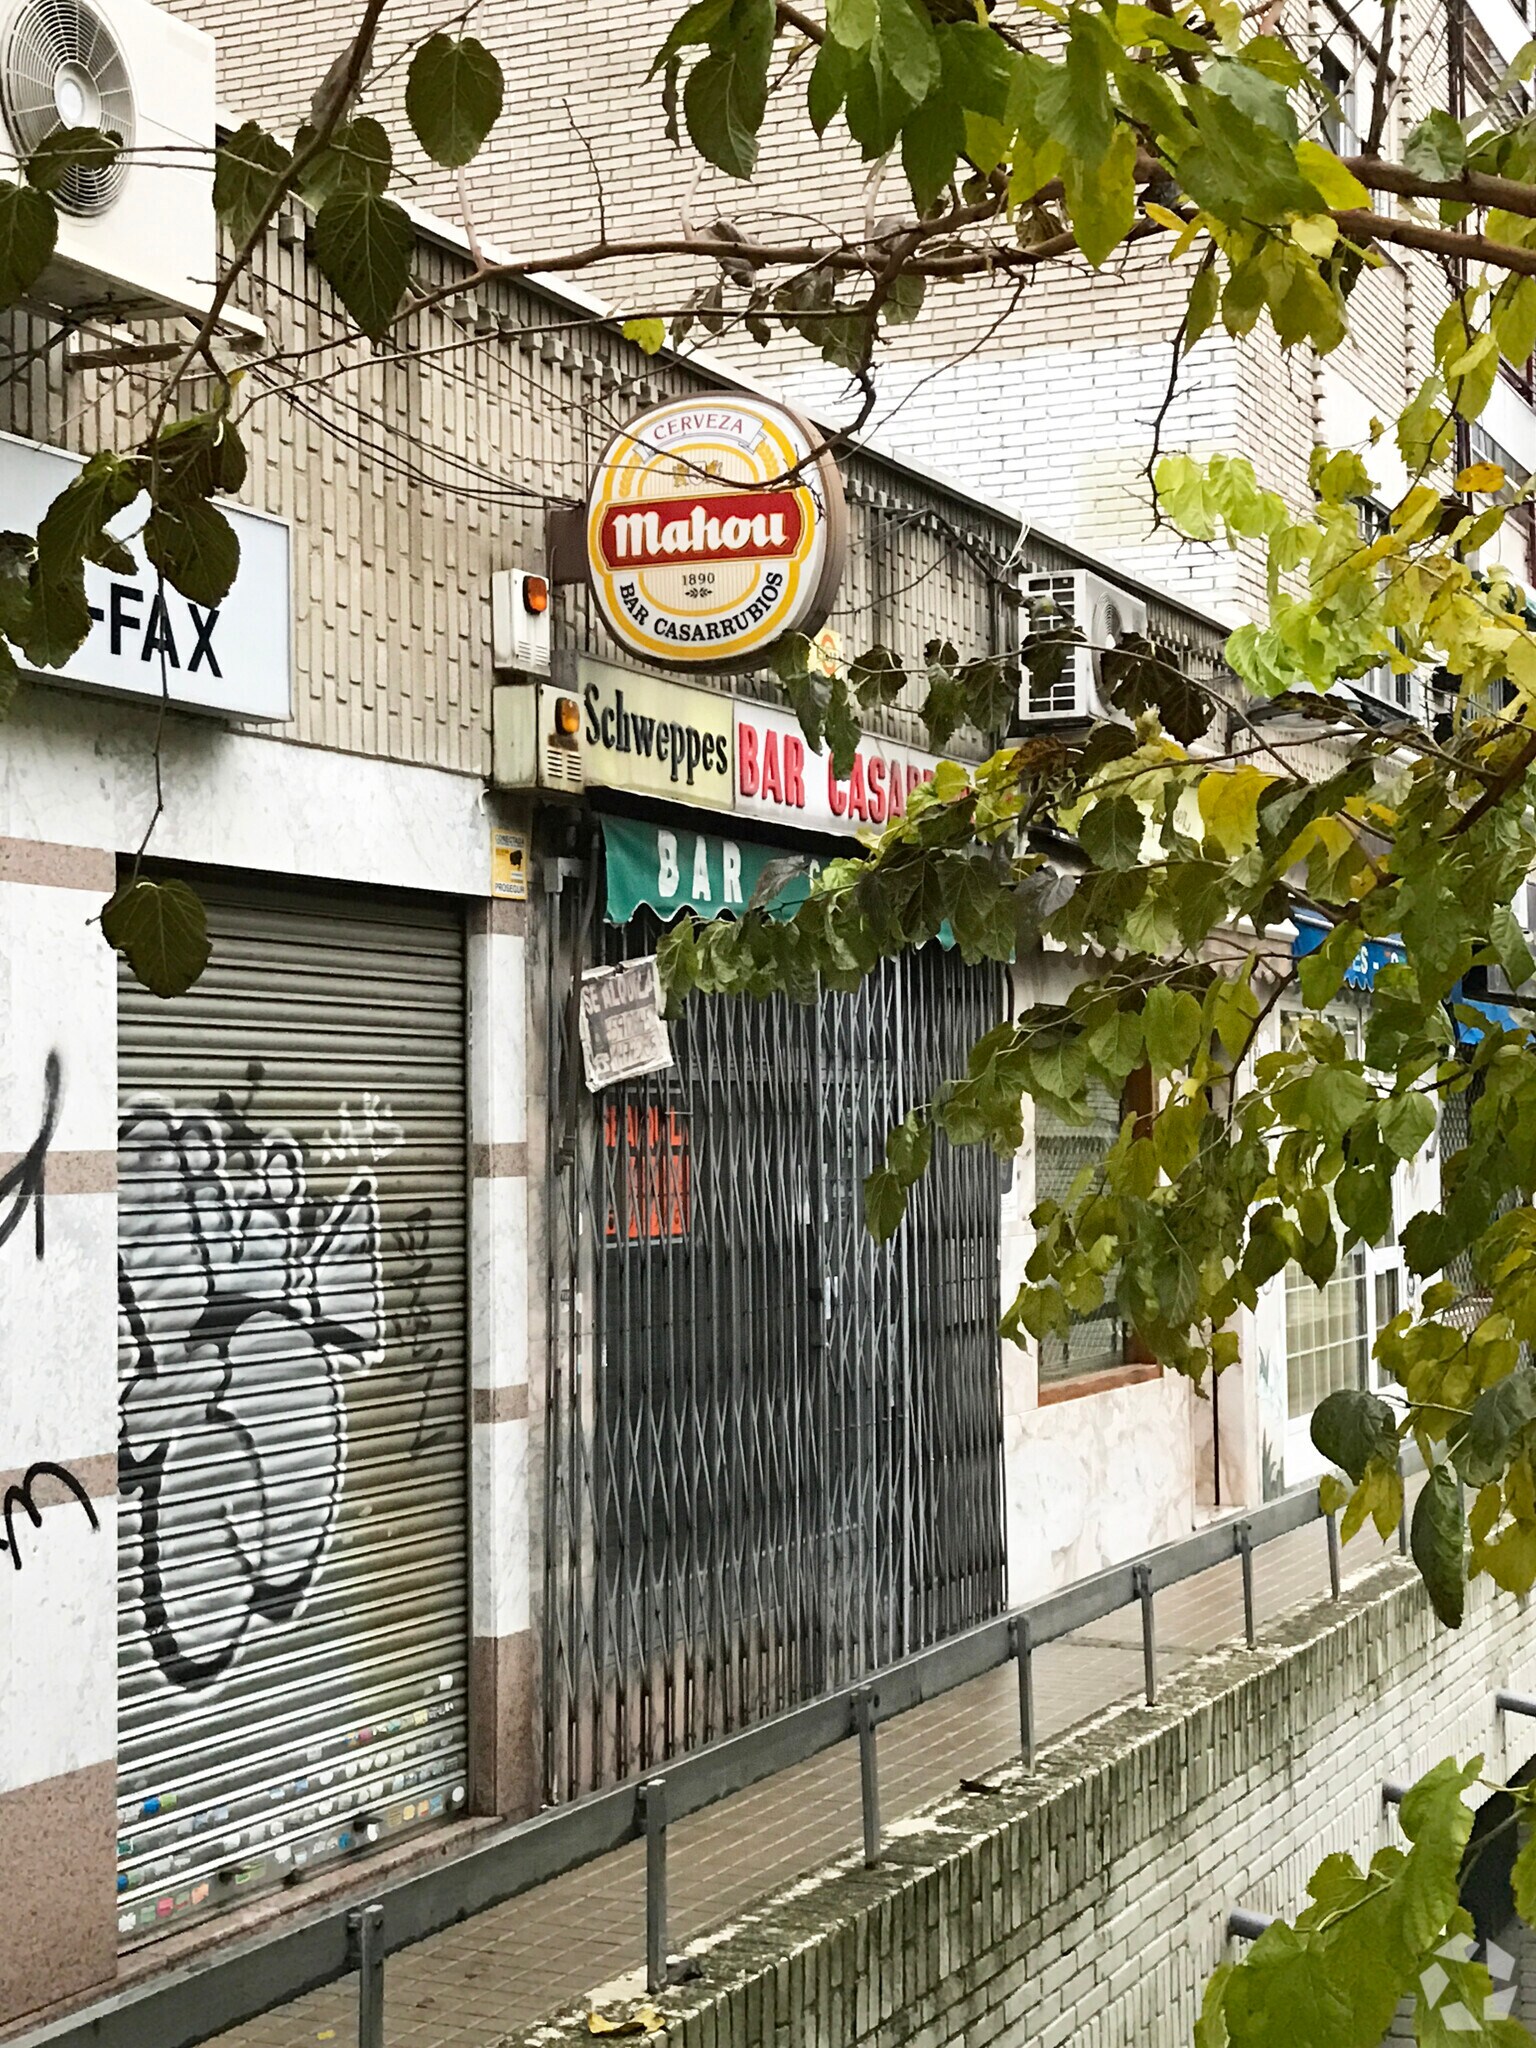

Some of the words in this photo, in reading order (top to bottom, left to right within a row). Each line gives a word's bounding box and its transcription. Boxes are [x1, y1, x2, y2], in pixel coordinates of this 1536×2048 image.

[653, 413, 743, 440] CERVEZA
[612, 505, 789, 558] Mahou
[619, 582, 649, 626] BAR
[654, 572, 784, 641] CASARRUBIOS
[681, 572, 715, 586] 1890
[584, 682, 729, 785] Schweppes
[738, 722, 805, 808] BAR
[658, 829, 744, 904] BAR
